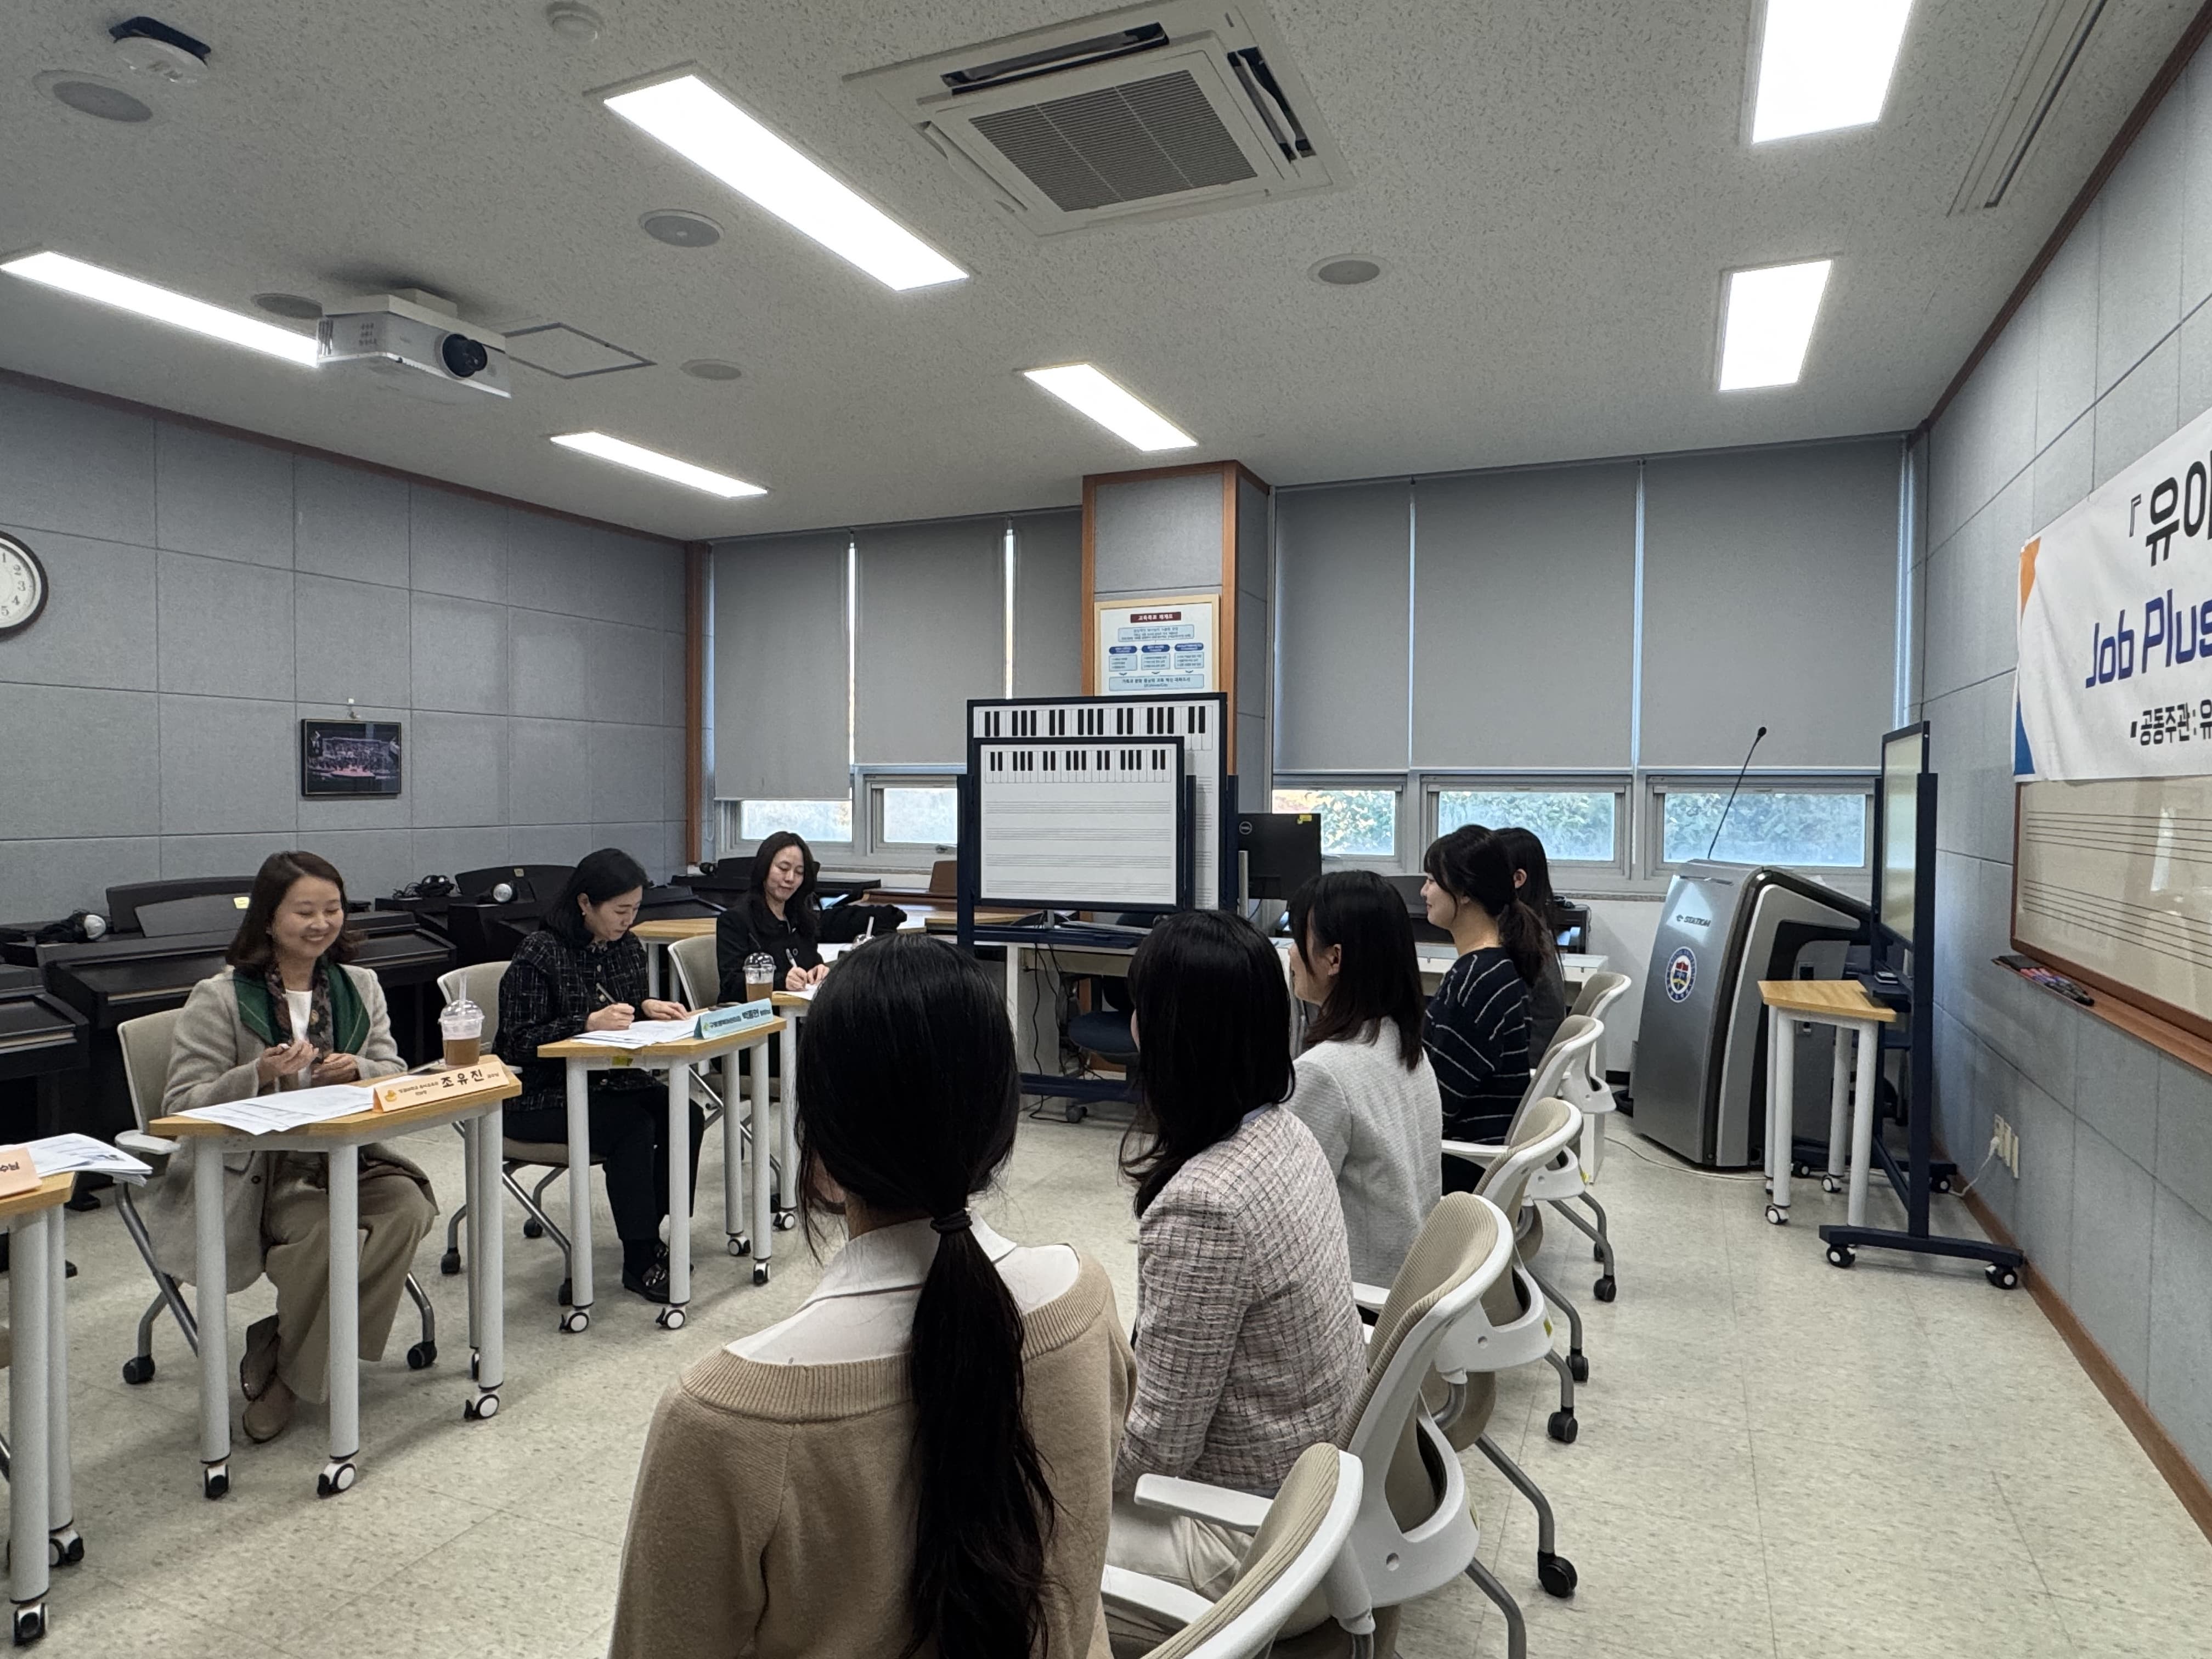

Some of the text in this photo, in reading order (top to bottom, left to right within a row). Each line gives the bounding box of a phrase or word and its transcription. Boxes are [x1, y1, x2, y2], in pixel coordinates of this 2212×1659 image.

[18, 581, 26, 591] 3
[12, 595, 20, 606] 4
[1, 606, 9, 616] 5
[2085, 609, 2135, 689] Job
